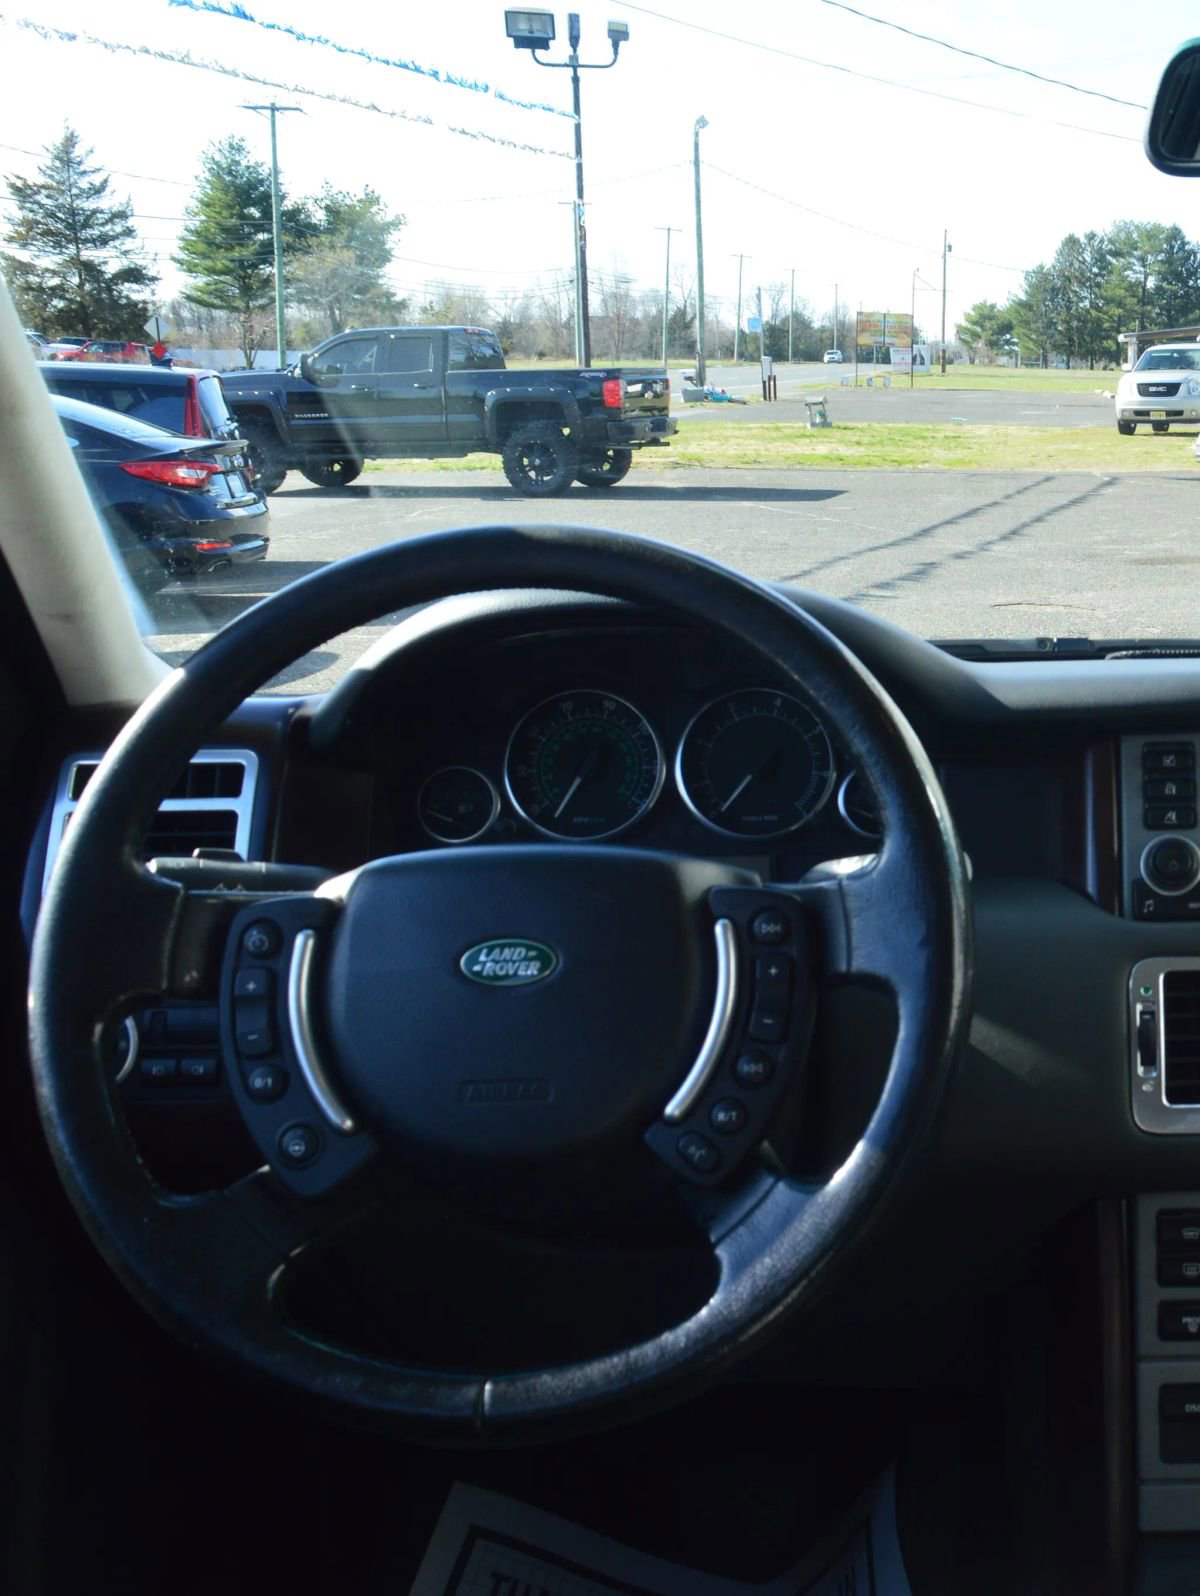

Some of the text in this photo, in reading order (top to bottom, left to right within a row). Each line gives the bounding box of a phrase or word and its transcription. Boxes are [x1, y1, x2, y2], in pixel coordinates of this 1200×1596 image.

[479, 948, 525, 961] LAND
[483, 961, 541, 976] ROVER
[255, 1075, 273, 1088] 0/1
[718, 1111, 738, 1122] R/T
